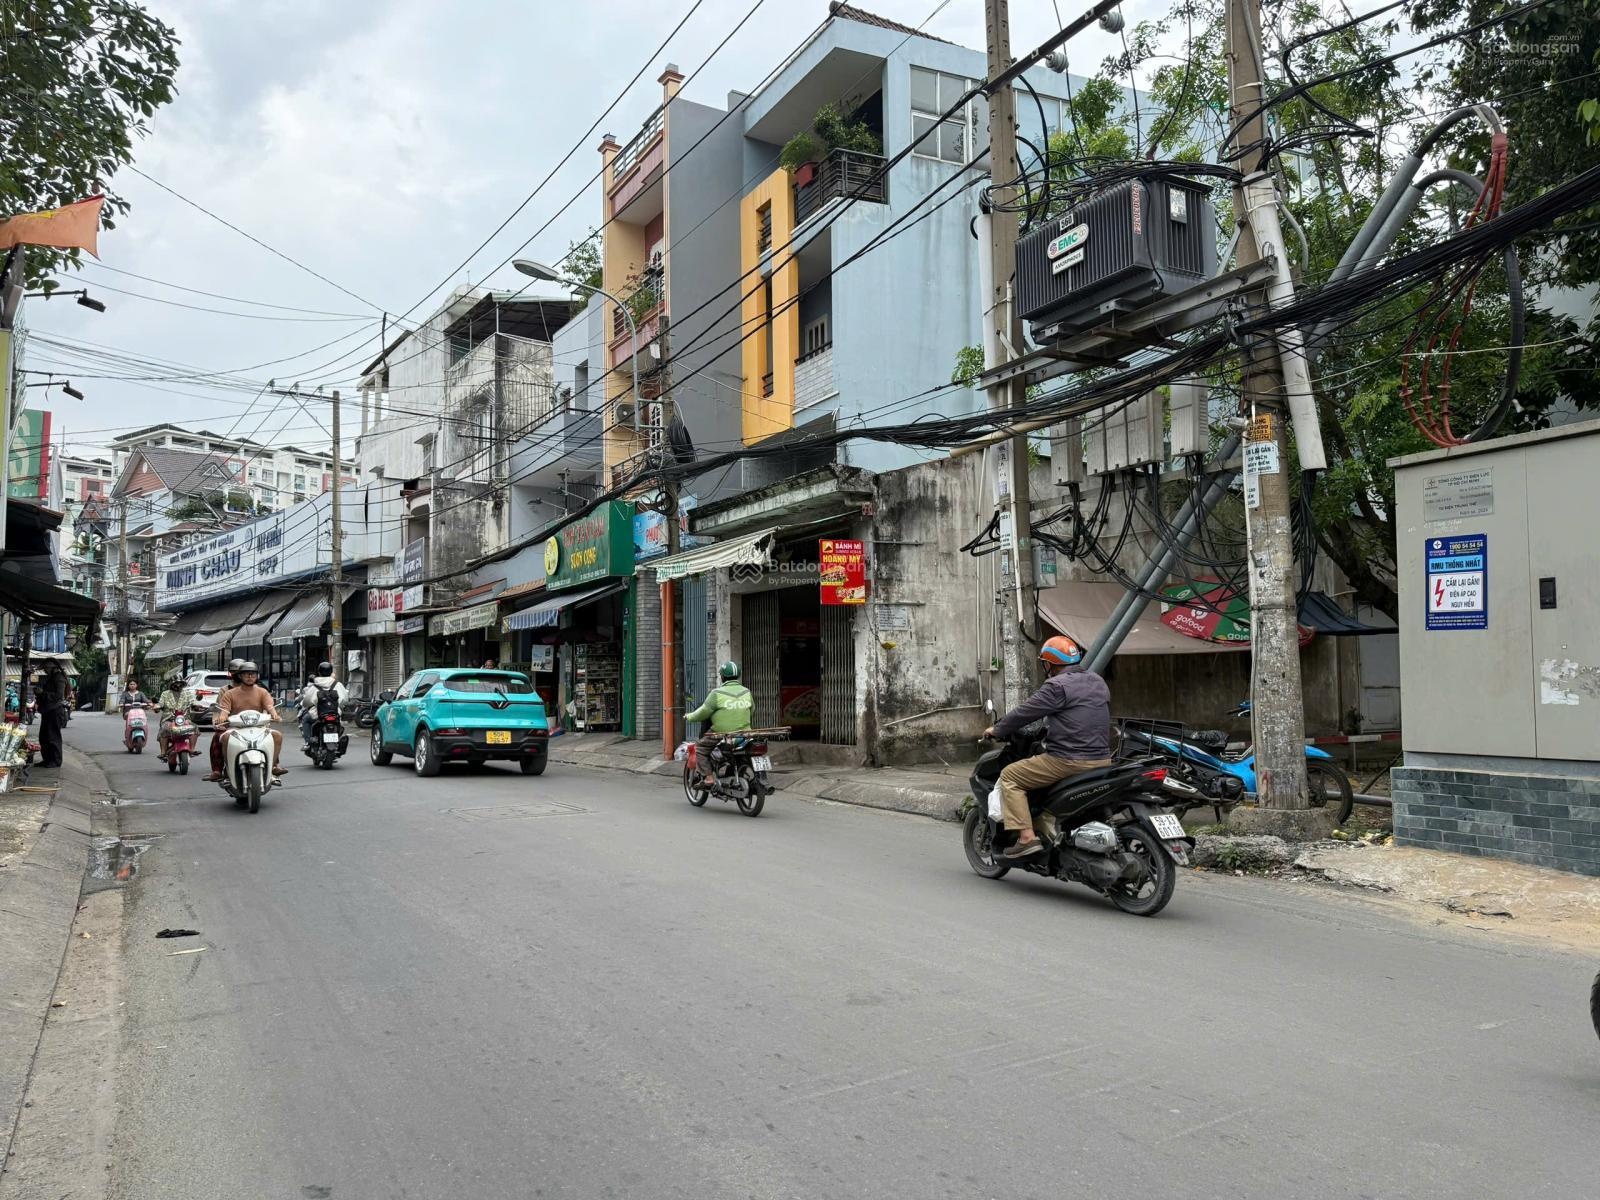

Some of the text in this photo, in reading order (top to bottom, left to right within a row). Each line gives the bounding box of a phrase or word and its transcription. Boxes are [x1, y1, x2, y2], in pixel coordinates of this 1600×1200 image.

[1058, 232, 1078, 250] EMC
[1055, 252, 1082, 270] AMORPHOUS
[201, 547, 241, 581] CHÂU
[1431, 557, 1481, 570] RMU THỐNG NHẤT
[1446, 576, 1457, 587] CẤM
[1450, 590, 1460, 598] ĐIỆN
[1464, 598, 1475, 607] HIỂM
[1175, 614, 1206, 632] gofood
[1227, 633, 1249, 641] goje
[725, 699, 752, 710] Grab
[1069, 784, 1110, 801] AIRBLADE
